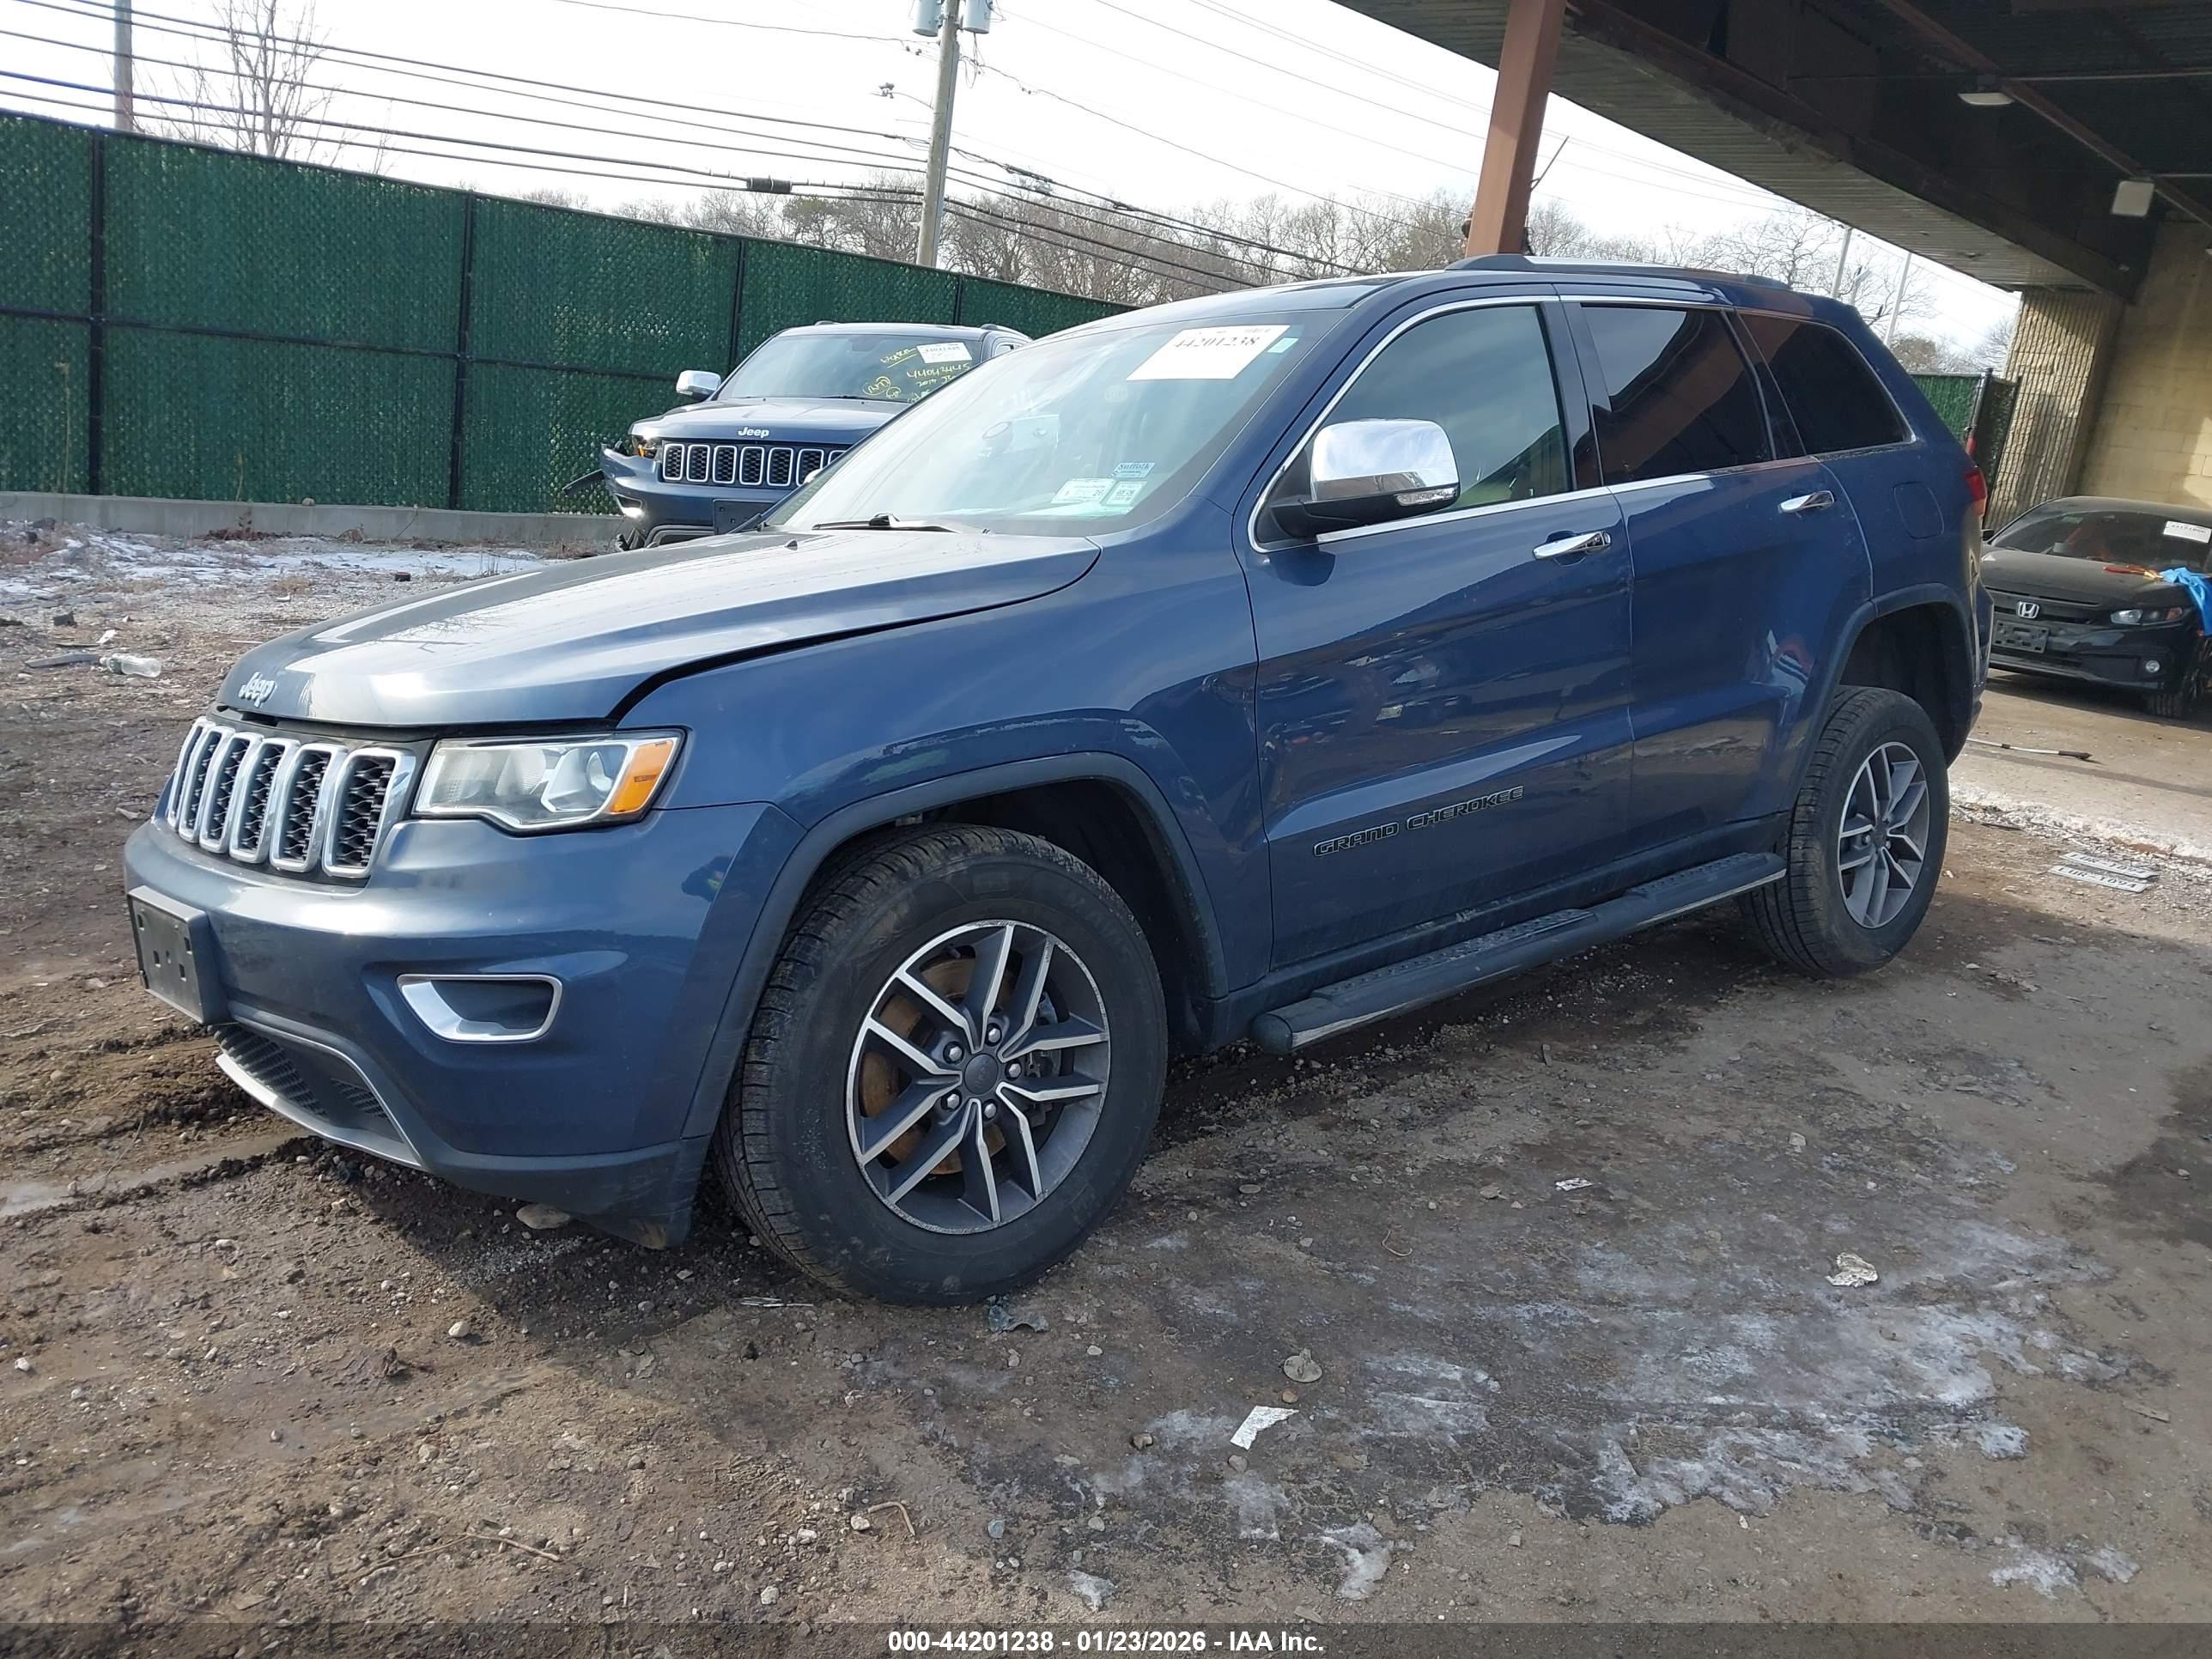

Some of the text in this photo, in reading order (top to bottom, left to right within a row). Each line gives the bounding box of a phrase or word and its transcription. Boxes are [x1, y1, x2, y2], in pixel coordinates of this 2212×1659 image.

[1174, 336, 1261, 348] 44201238
[738, 426, 770, 439] Jeep
[238, 672, 278, 708] Jeep
[1315, 786, 1524, 857] GRAND CHEROKEE
